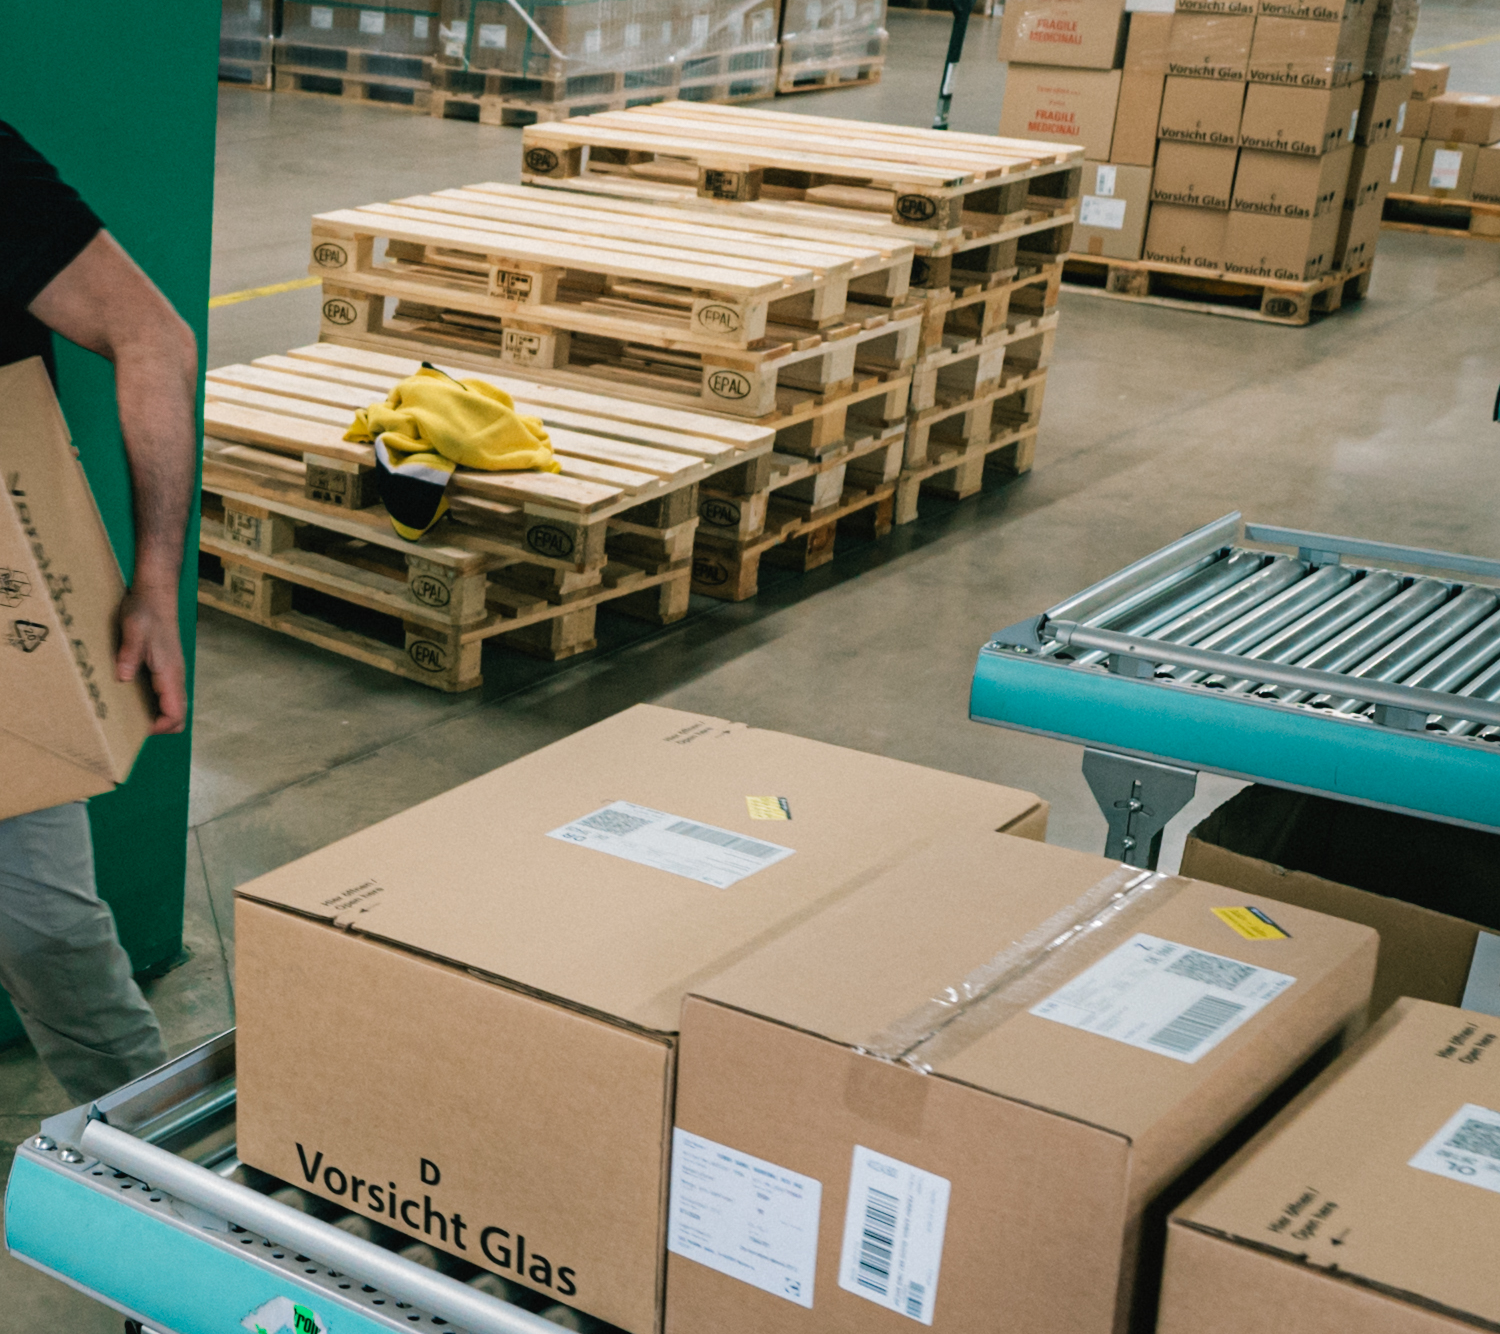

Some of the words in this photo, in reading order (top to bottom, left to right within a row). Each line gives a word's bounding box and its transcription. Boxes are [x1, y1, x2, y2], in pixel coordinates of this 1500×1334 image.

[1228, 1, 1254, 14] Glas
[1313, 6, 1339, 20] Glas
[1037, 18, 1078, 33] FRAGILE
[1169, 62, 1215, 76] Vorsicht
[1250, 70, 1298, 84] Vorsicht
[1301, 73, 1327, 87] Glas
[1035, 109, 1076, 124] FRAGILE
[1161, 126, 1206, 141] Vorsicht
[1209, 131, 1234, 145] Glas
[1241, 135, 1289, 150] Vorsicht
[1291, 140, 1317, 155] Glas
[901, 198, 928, 216] EPAL
[1154, 189, 1200, 204] Vorsicht
[1202, 194, 1227, 208] Glas
[1234, 198, 1282, 214] Vorsicht
[1284, 204, 1310, 218] Glas
[318, 246, 343, 264] EPAL
[1146, 251, 1191, 266] Vorsicht
[1194, 256, 1218, 269] Glas
[1224, 261, 1271, 277] Vorsicht
[1274, 267, 1299, 281] Glas
[327, 303, 352, 322] EPAL
[704, 308, 735, 328] EPAL
[712, 374, 745, 395] EPAL
[705, 502, 736, 524] EPAL
[533, 528, 570, 555] EPAL
[414, 643, 443, 666] EPAL
[320, 894, 342, 908] Hier
[334, 898, 359, 912] Open
[360, 886, 385, 900] here
[420, 1157, 441, 1186] D
[295, 1142, 467, 1251] Vorsicht
[479, 1226, 577, 1296] Glas
